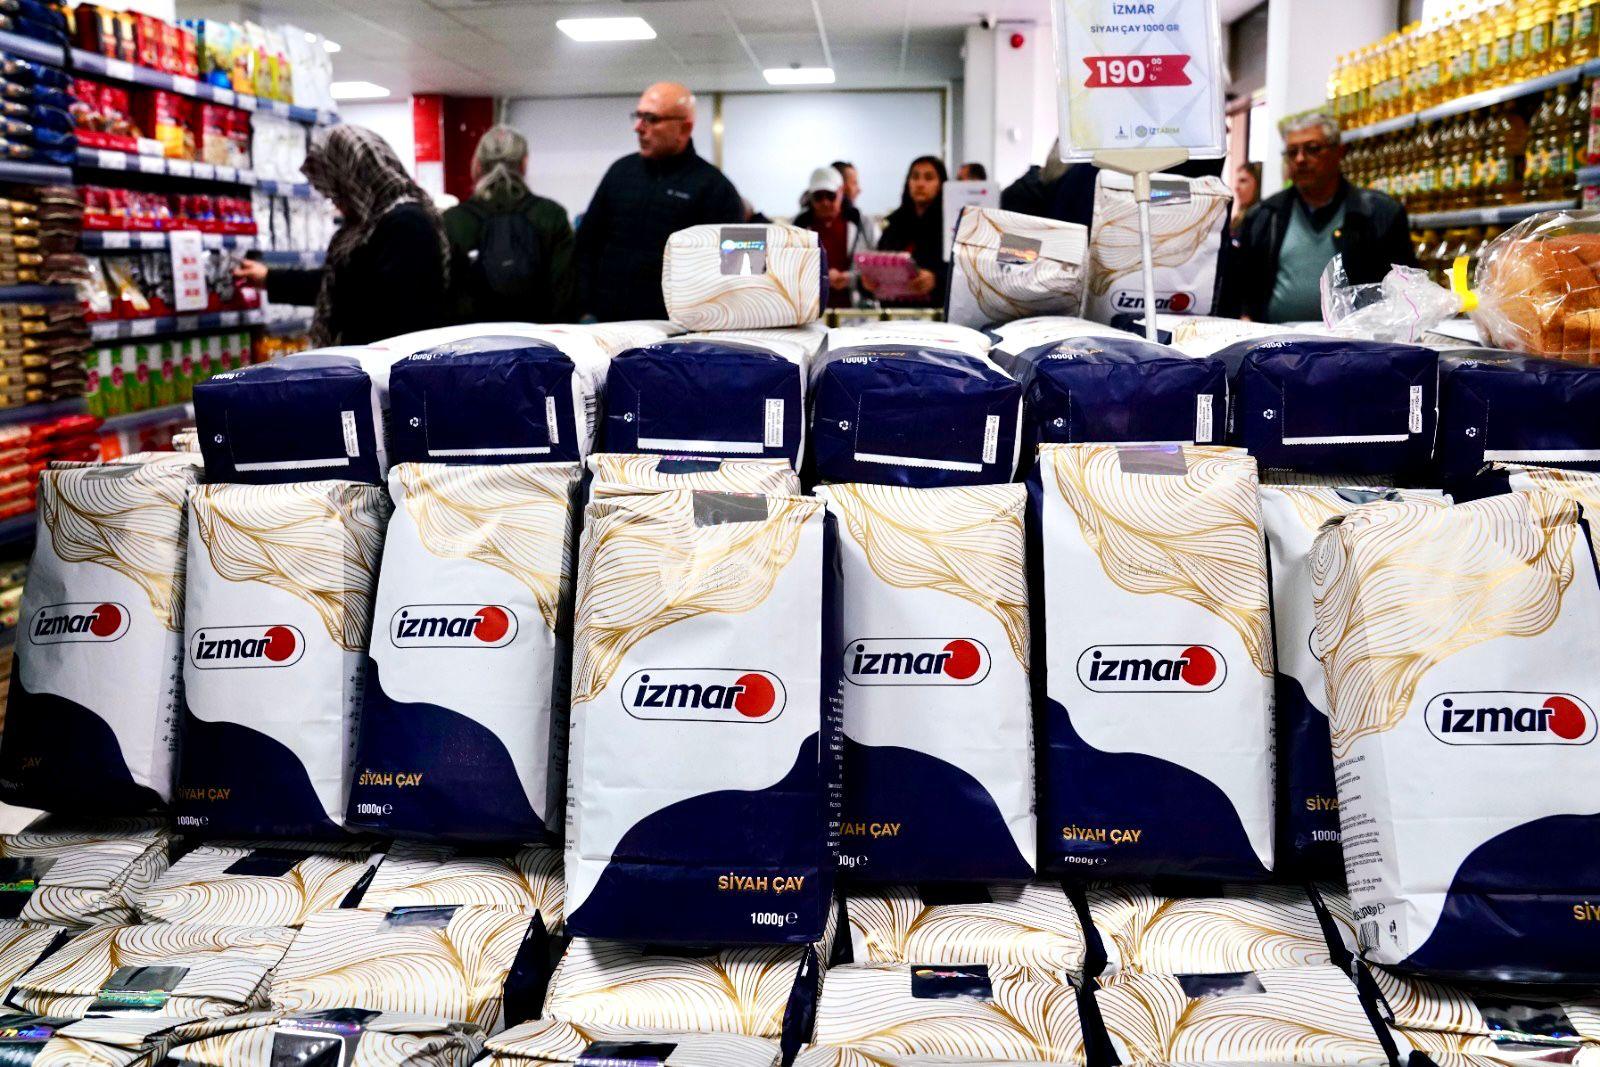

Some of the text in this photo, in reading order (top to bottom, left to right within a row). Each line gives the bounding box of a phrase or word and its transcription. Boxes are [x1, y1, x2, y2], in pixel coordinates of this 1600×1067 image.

[1113, 4, 1155, 15] İZMAR
[1090, 23, 1180, 35] SİYAH ÇAY 1000 GR
[34, 611, 99, 637] izmar
[396, 610, 484, 639] izmar
[195, 633, 272, 660] izmar
[851, 643, 953, 676] izmar
[1088, 650, 1191, 682] izmar
[633, 674, 746, 710] izmar
[1440, 697, 1554, 734] izmar
[358, 768, 423, 789] SİYAH ÇAY
[207, 788, 231, 802] ÇAY
[1306, 795, 1339, 811] SİYA
[357, 803, 382, 816] 1000g
[839, 822, 902, 839] YAH ÇAY
[1062, 826, 1142, 845] SİYAH ÇAY
[717, 872, 805, 895] SİYAH ÇAY
[750, 911, 784, 927] 1000g
[1572, 900, 1600, 921] SİY
